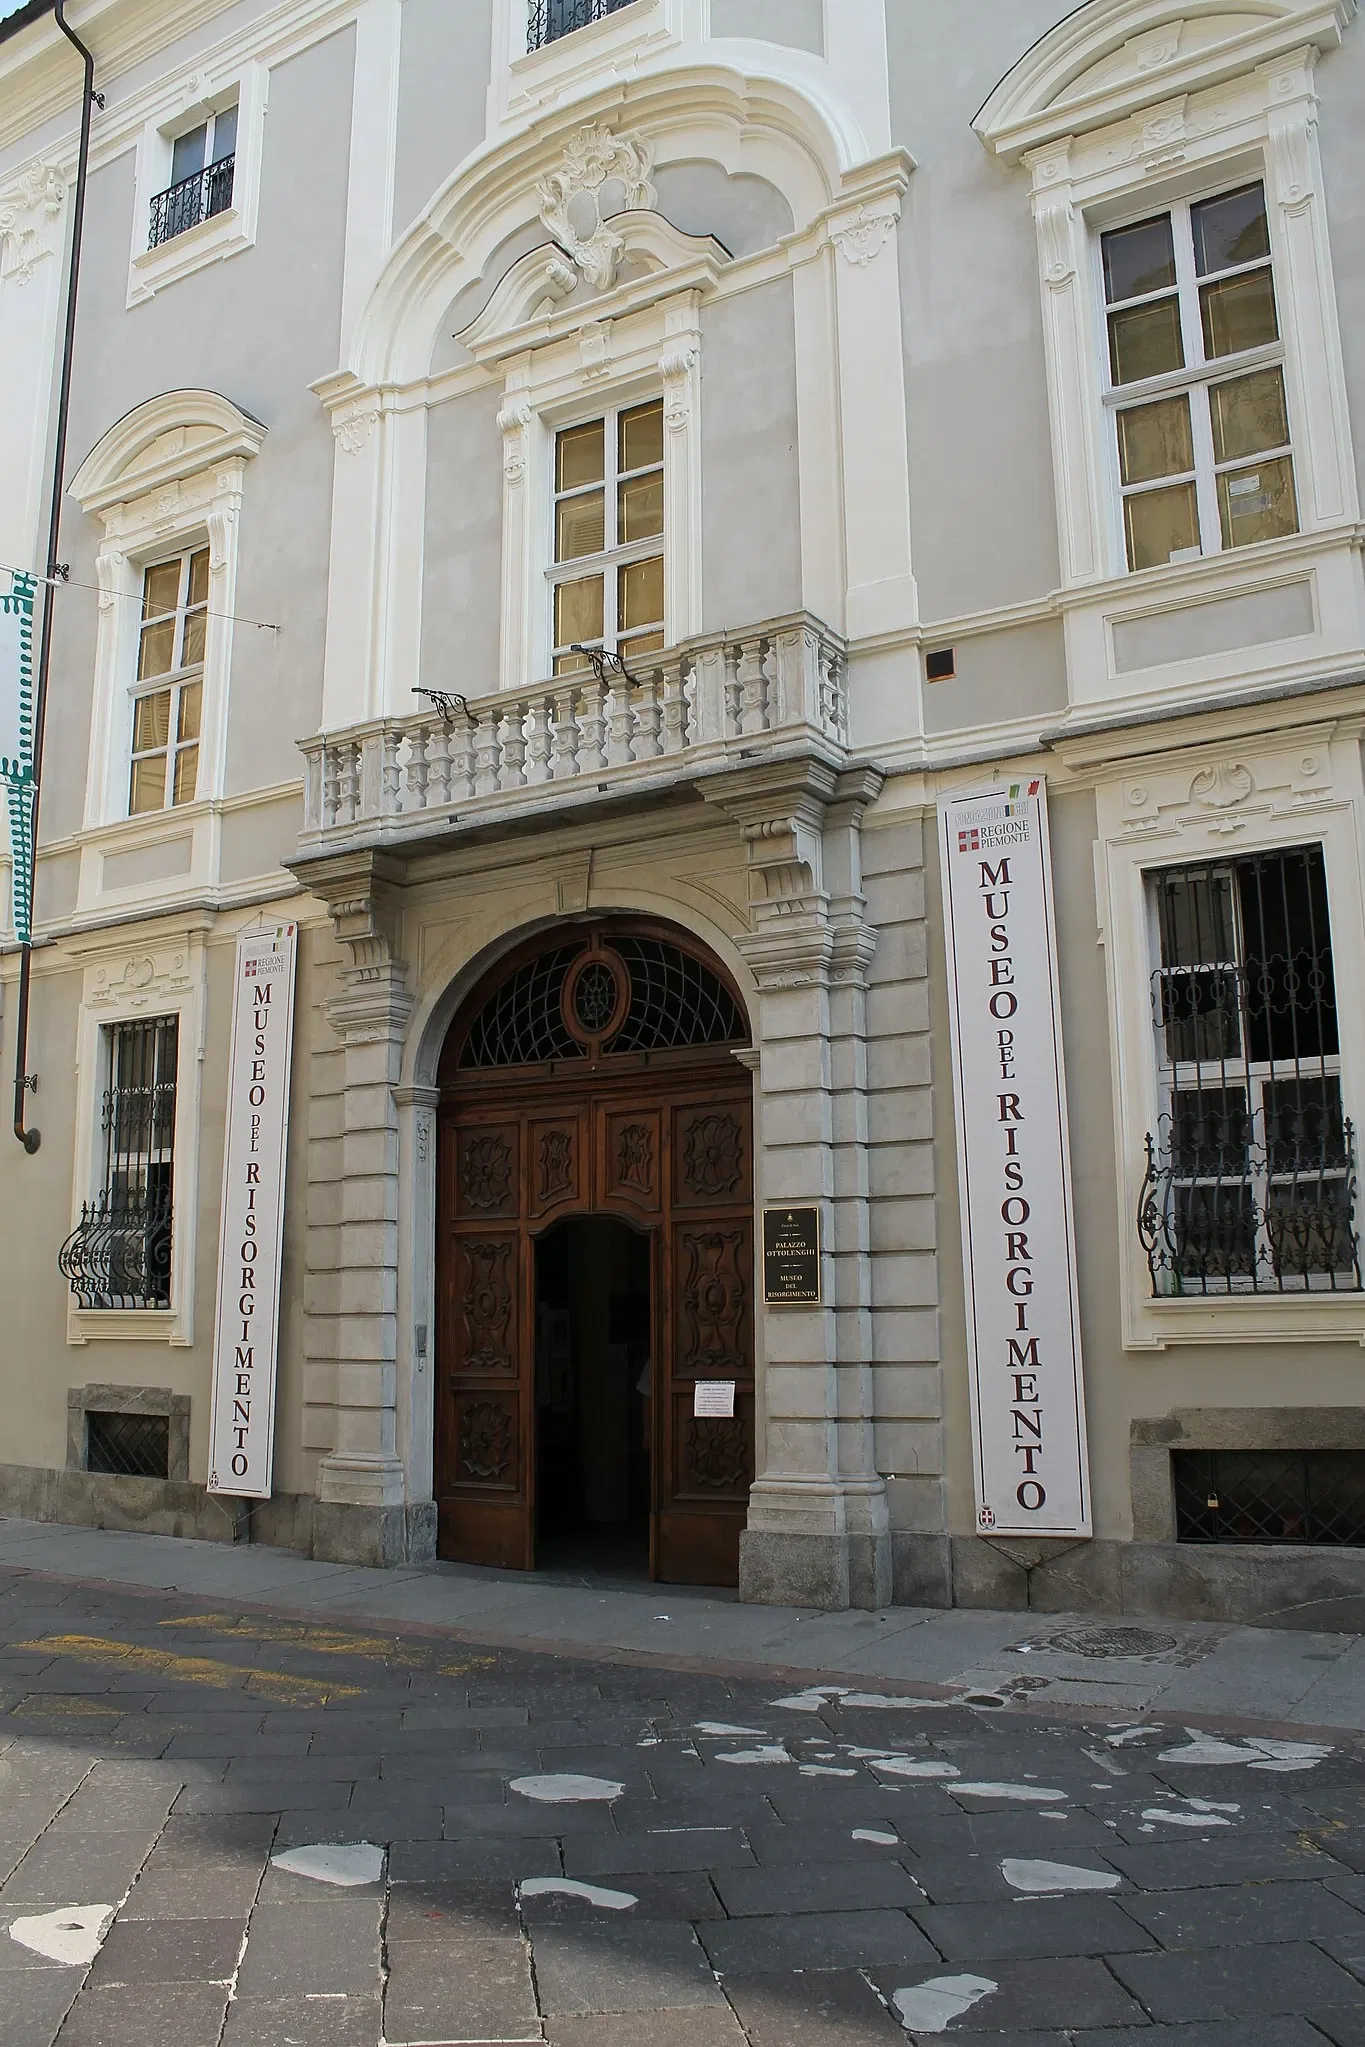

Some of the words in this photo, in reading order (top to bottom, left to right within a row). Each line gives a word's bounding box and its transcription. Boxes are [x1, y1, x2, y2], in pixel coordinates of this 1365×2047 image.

[955, 804, 1005, 826] FONDAZIONE
[980, 820, 1029, 838] REGIONE
[981, 832, 1030, 849] PIEMONTE
[978, 857, 1018, 1019] MUSEO
[257, 955, 285, 967] REGIONE
[257, 964, 284, 975] PIEMONTE
[249, 983, 272, 1107] MUSEO
[997, 1030, 1015, 1079] DEL
[250, 1114, 261, 1152] DEL
[766, 1249, 815, 1257] OTTOLENGHI
[775, 1241, 806, 1249] PALAZZO
[997, 1093, 1046, 1510] RISORGIMENTO
[231, 1162, 261, 1476] RISORGIMENTO
